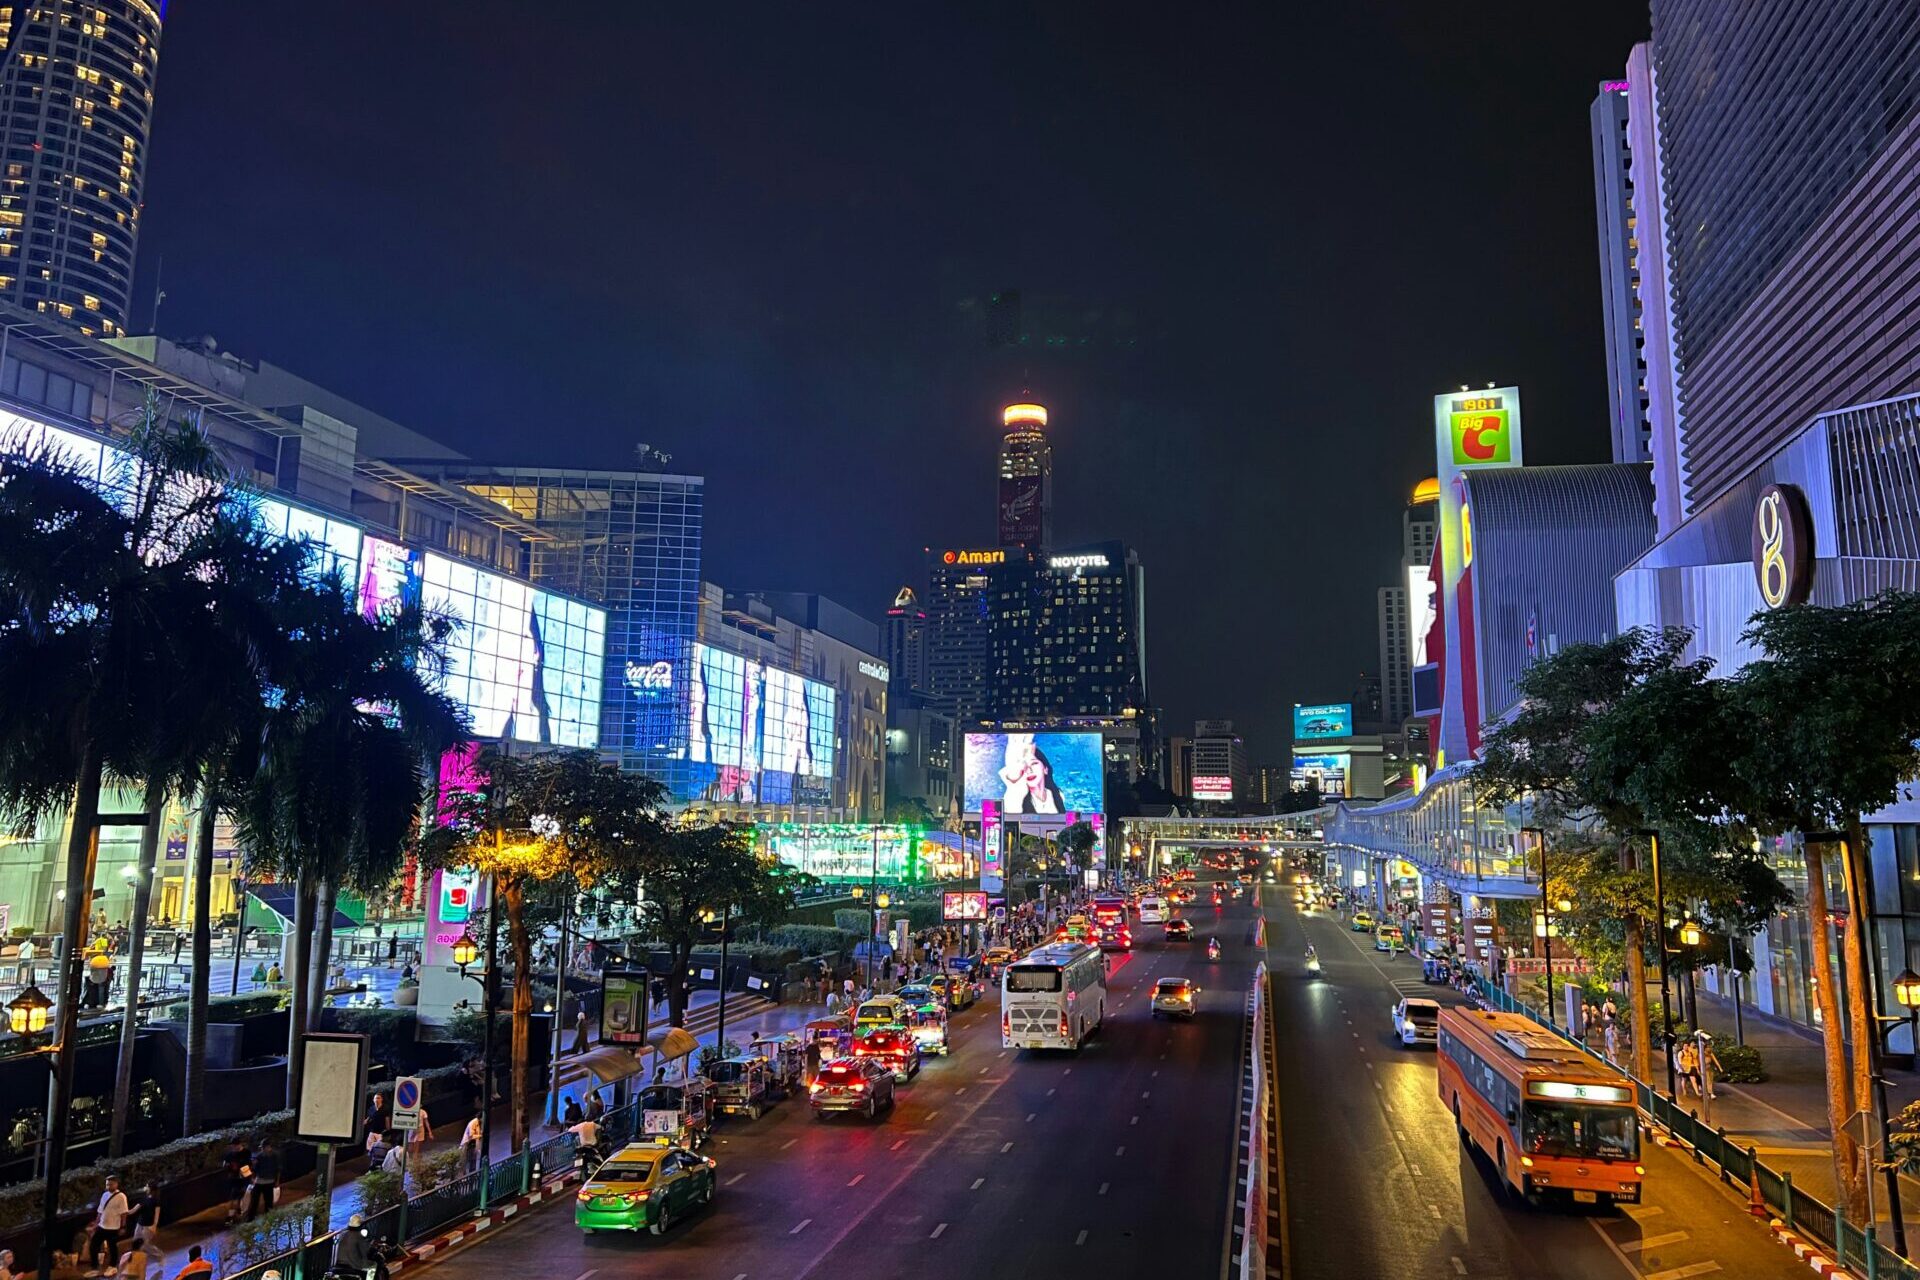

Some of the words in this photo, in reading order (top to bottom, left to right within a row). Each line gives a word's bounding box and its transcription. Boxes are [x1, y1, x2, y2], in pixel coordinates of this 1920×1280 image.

[1459, 416, 1484, 431] Big
[1462, 416, 1501, 460] C
[957, 550, 1005, 564] Amari
[1051, 555, 1109, 567] NOVOTEL
[1574, 1087, 1587, 1096] 76
